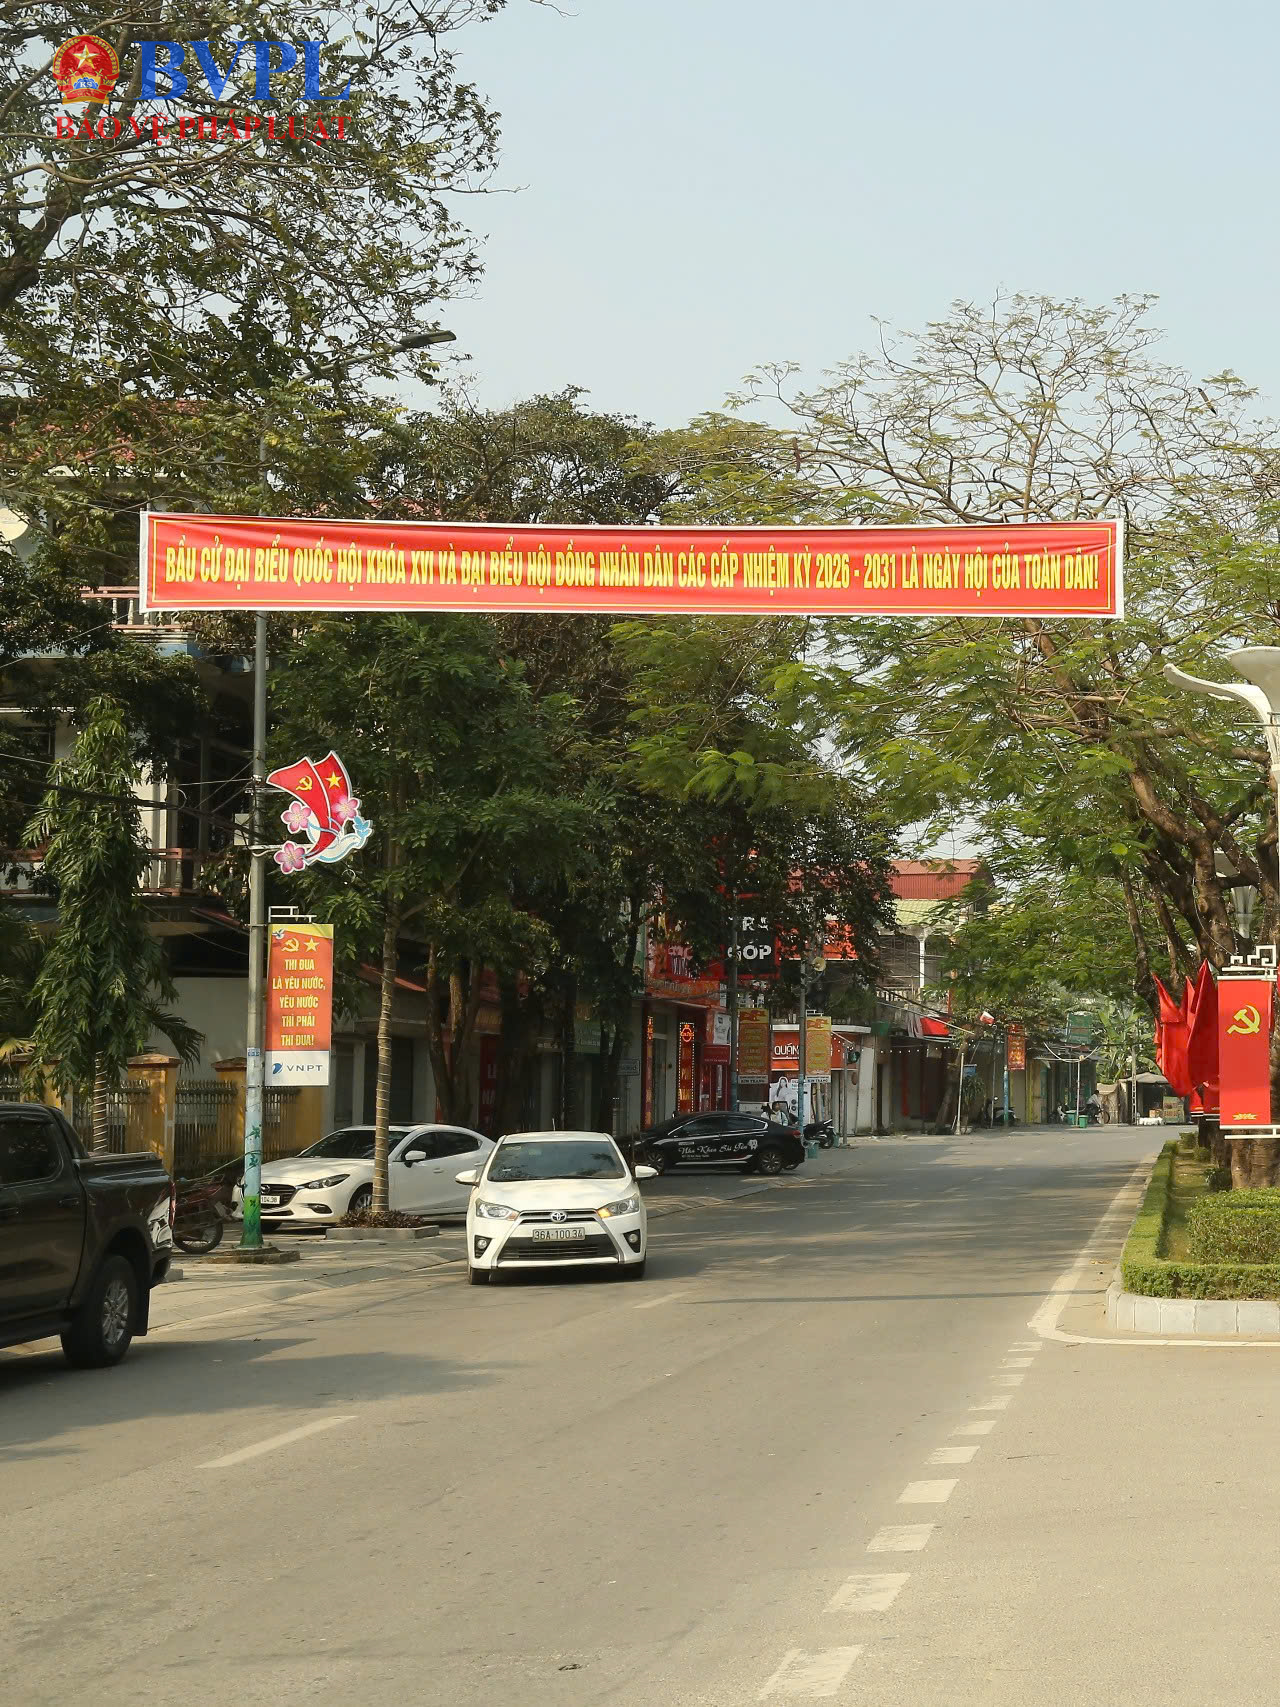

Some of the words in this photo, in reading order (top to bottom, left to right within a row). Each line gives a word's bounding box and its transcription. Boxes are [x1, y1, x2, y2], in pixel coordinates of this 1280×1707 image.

[165, 535, 197, 583] BẦU
[199, 535, 223, 583] CỬ
[225, 548, 251, 591] ĐẠI
[255, 533, 289, 583] BIỂU
[293, 536, 333, 587] QUỐC
[337, 543, 364, 592] HỘI
[366, 543, 406, 585] KHÓA
[410, 548, 435, 586] XVI
[437, 543, 458, 586] VÀ
[460, 549, 487, 593] ĐẠI
[489, 536, 524, 587] BIỂU
[526, 543, 553, 594] HỘI
[555, 538, 596, 588] ĐỒNG
[599, 544, 640, 588] NHÂN
[643, 545, 674, 588] DÂN
[678, 545, 706, 588] CÁC
[710, 541, 739, 588] CẤP
[743, 545, 789, 596] NHIỆM
[793, 546, 812, 588] KỲ
[816, 552, 850, 589] 2026
[863, 552, 896, 589] 2031
[902, 546, 919, 589] LÀ
[922, 546, 959, 590] NGÀY
[963, 546, 989, 597] HỘI
[992, 541, 1021, 590] CỦA
[1023, 543, 1062, 590] TOÀN
[1064, 547, 1100, 590] DÂN!
[728, 941, 772, 960] GÓP
[284, 959, 297, 970] THI
[299, 959, 314, 970] ĐUA
[272, 977, 282, 990] LÀ
[284, 977, 299, 990] YÊU
[302, 976, 326, 990] NƯỚC,
[280, 996, 294, 1008] YÊU
[297, 996, 318, 1008] NƯỚC
[296, 1012, 314, 1027] PHẢI
[280, 1034, 294, 1046] THI
[296, 1034, 314, 1046] ĐUA!
[774, 1043, 799, 1056] QUÁN
